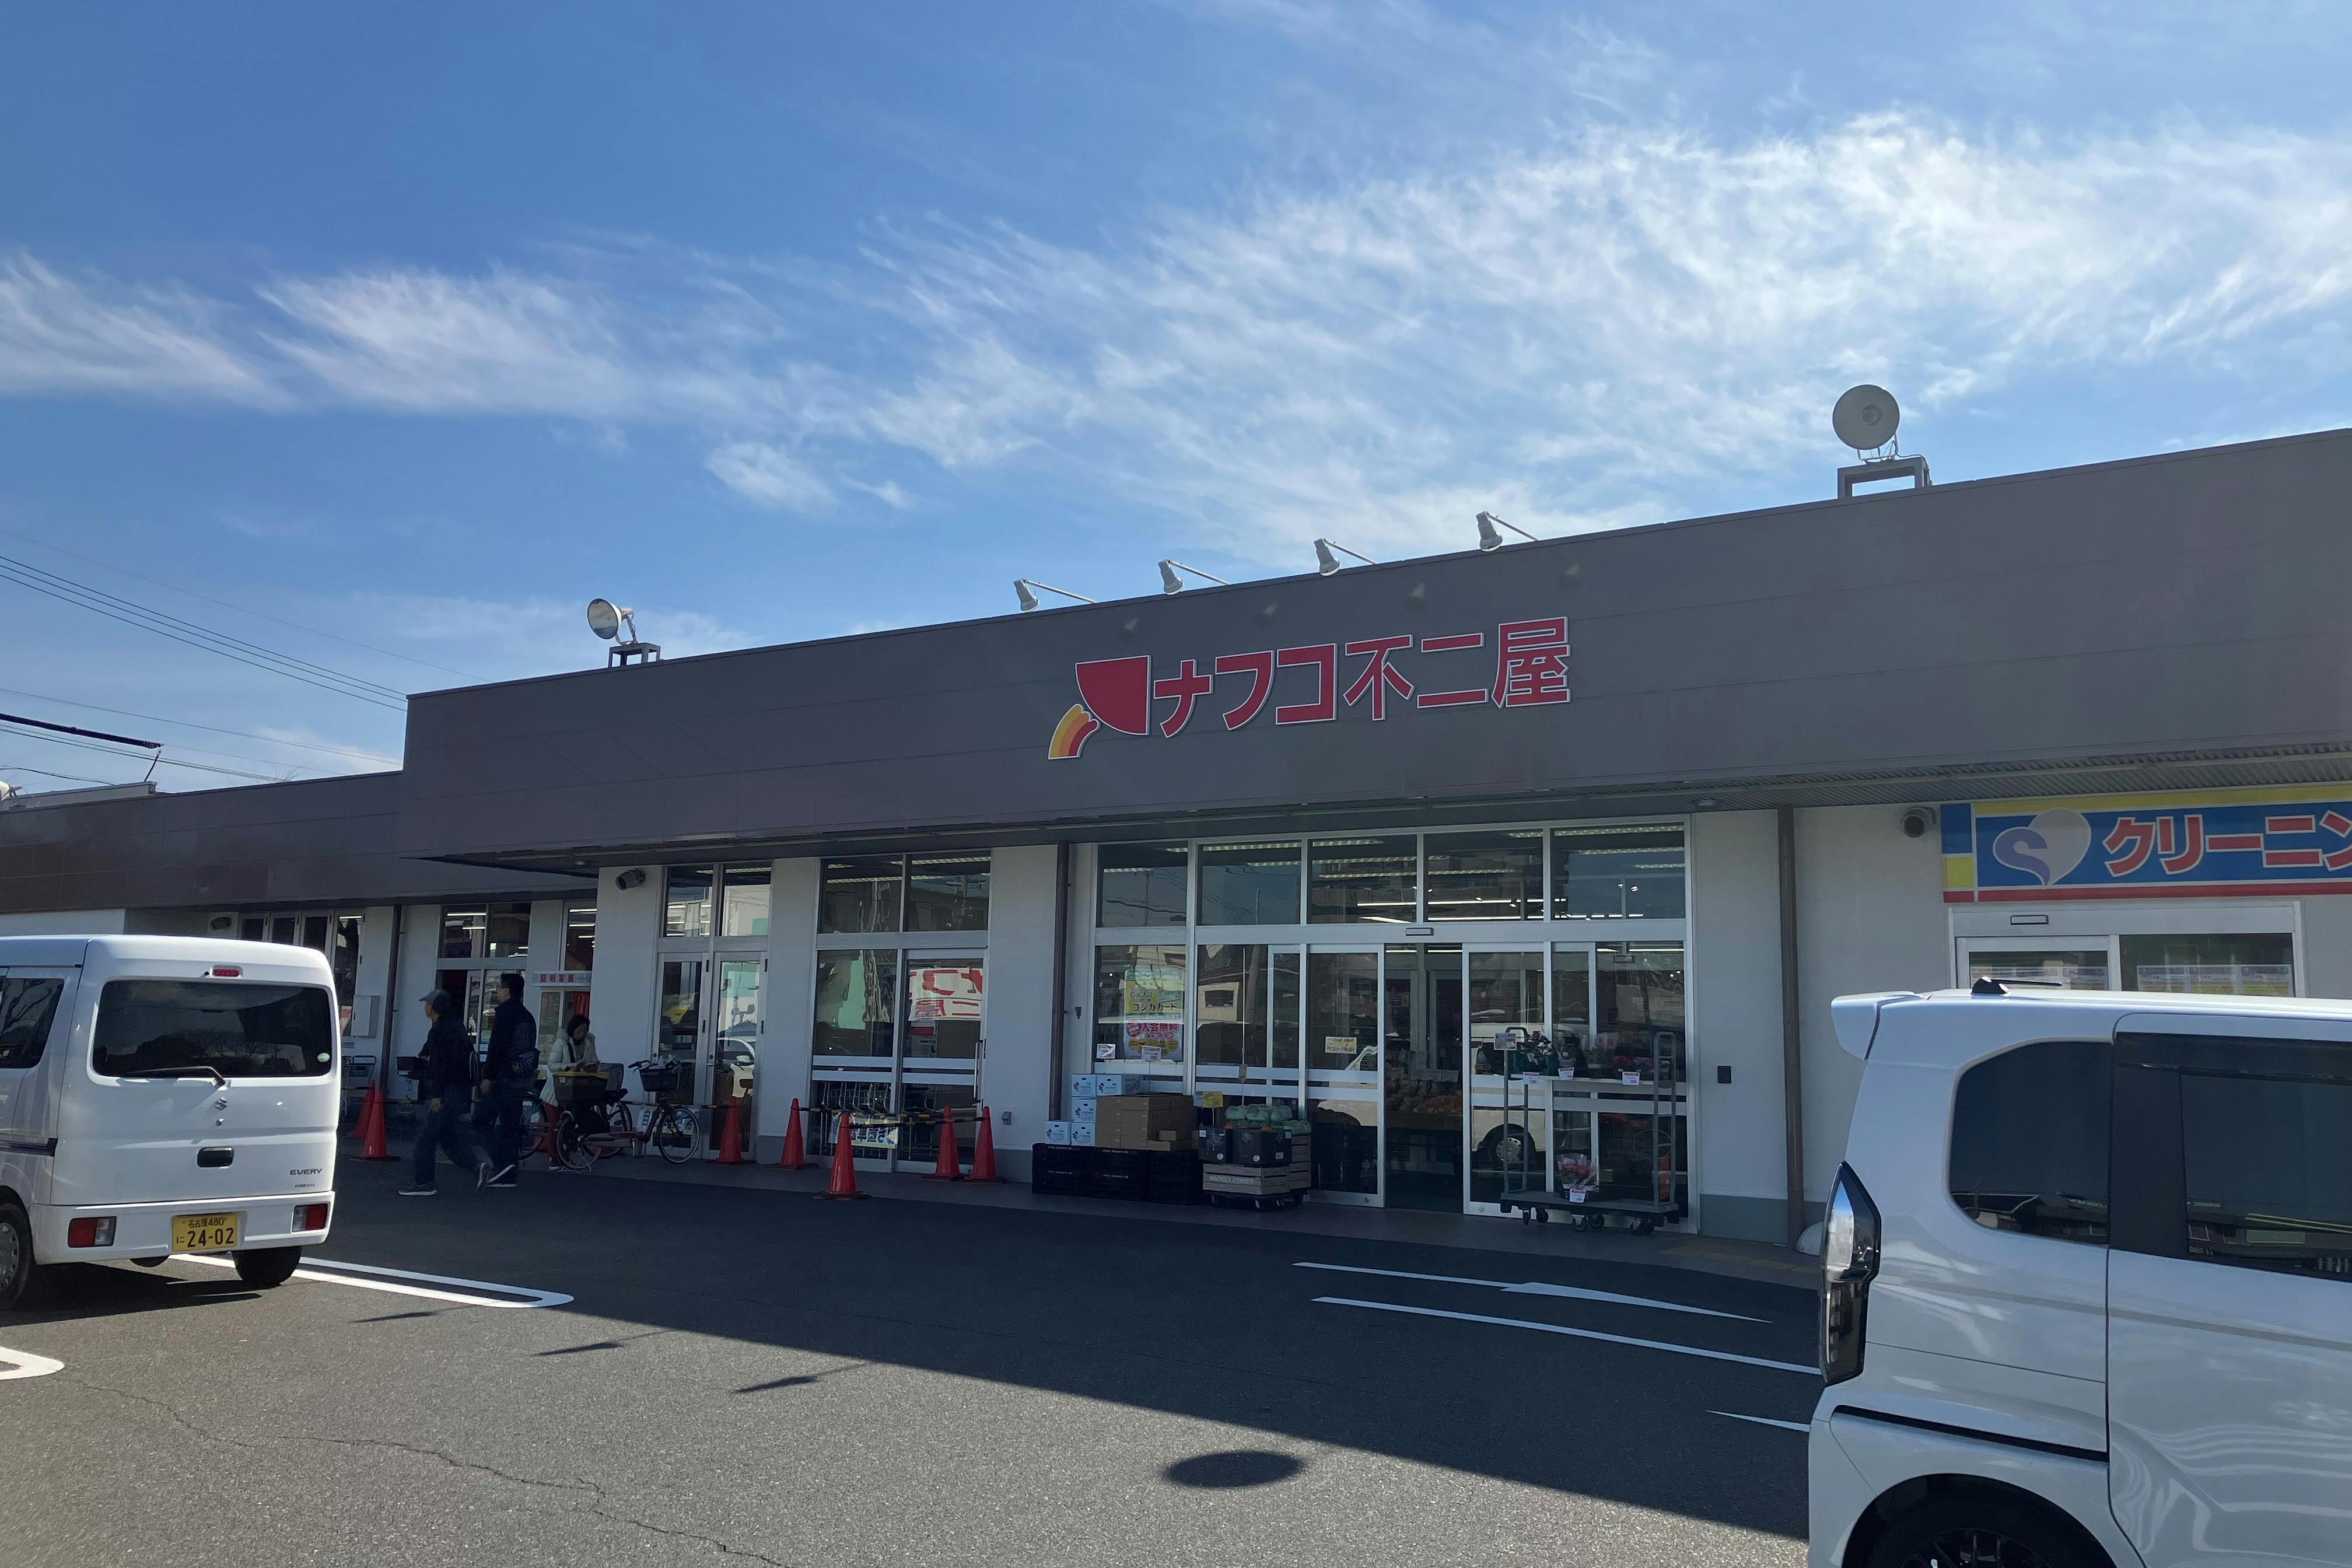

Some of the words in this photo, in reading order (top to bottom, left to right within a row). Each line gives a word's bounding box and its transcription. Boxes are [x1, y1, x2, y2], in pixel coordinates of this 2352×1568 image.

[1153, 616, 1572, 739] ナフコ不二屋
[1133, 1003, 1177, 1012] コジカカード
[1140, 1022, 1179, 1032] 入会無料
[177, 1236, 185, 1244] に
[187, 1227, 235, 1248] 24-02
